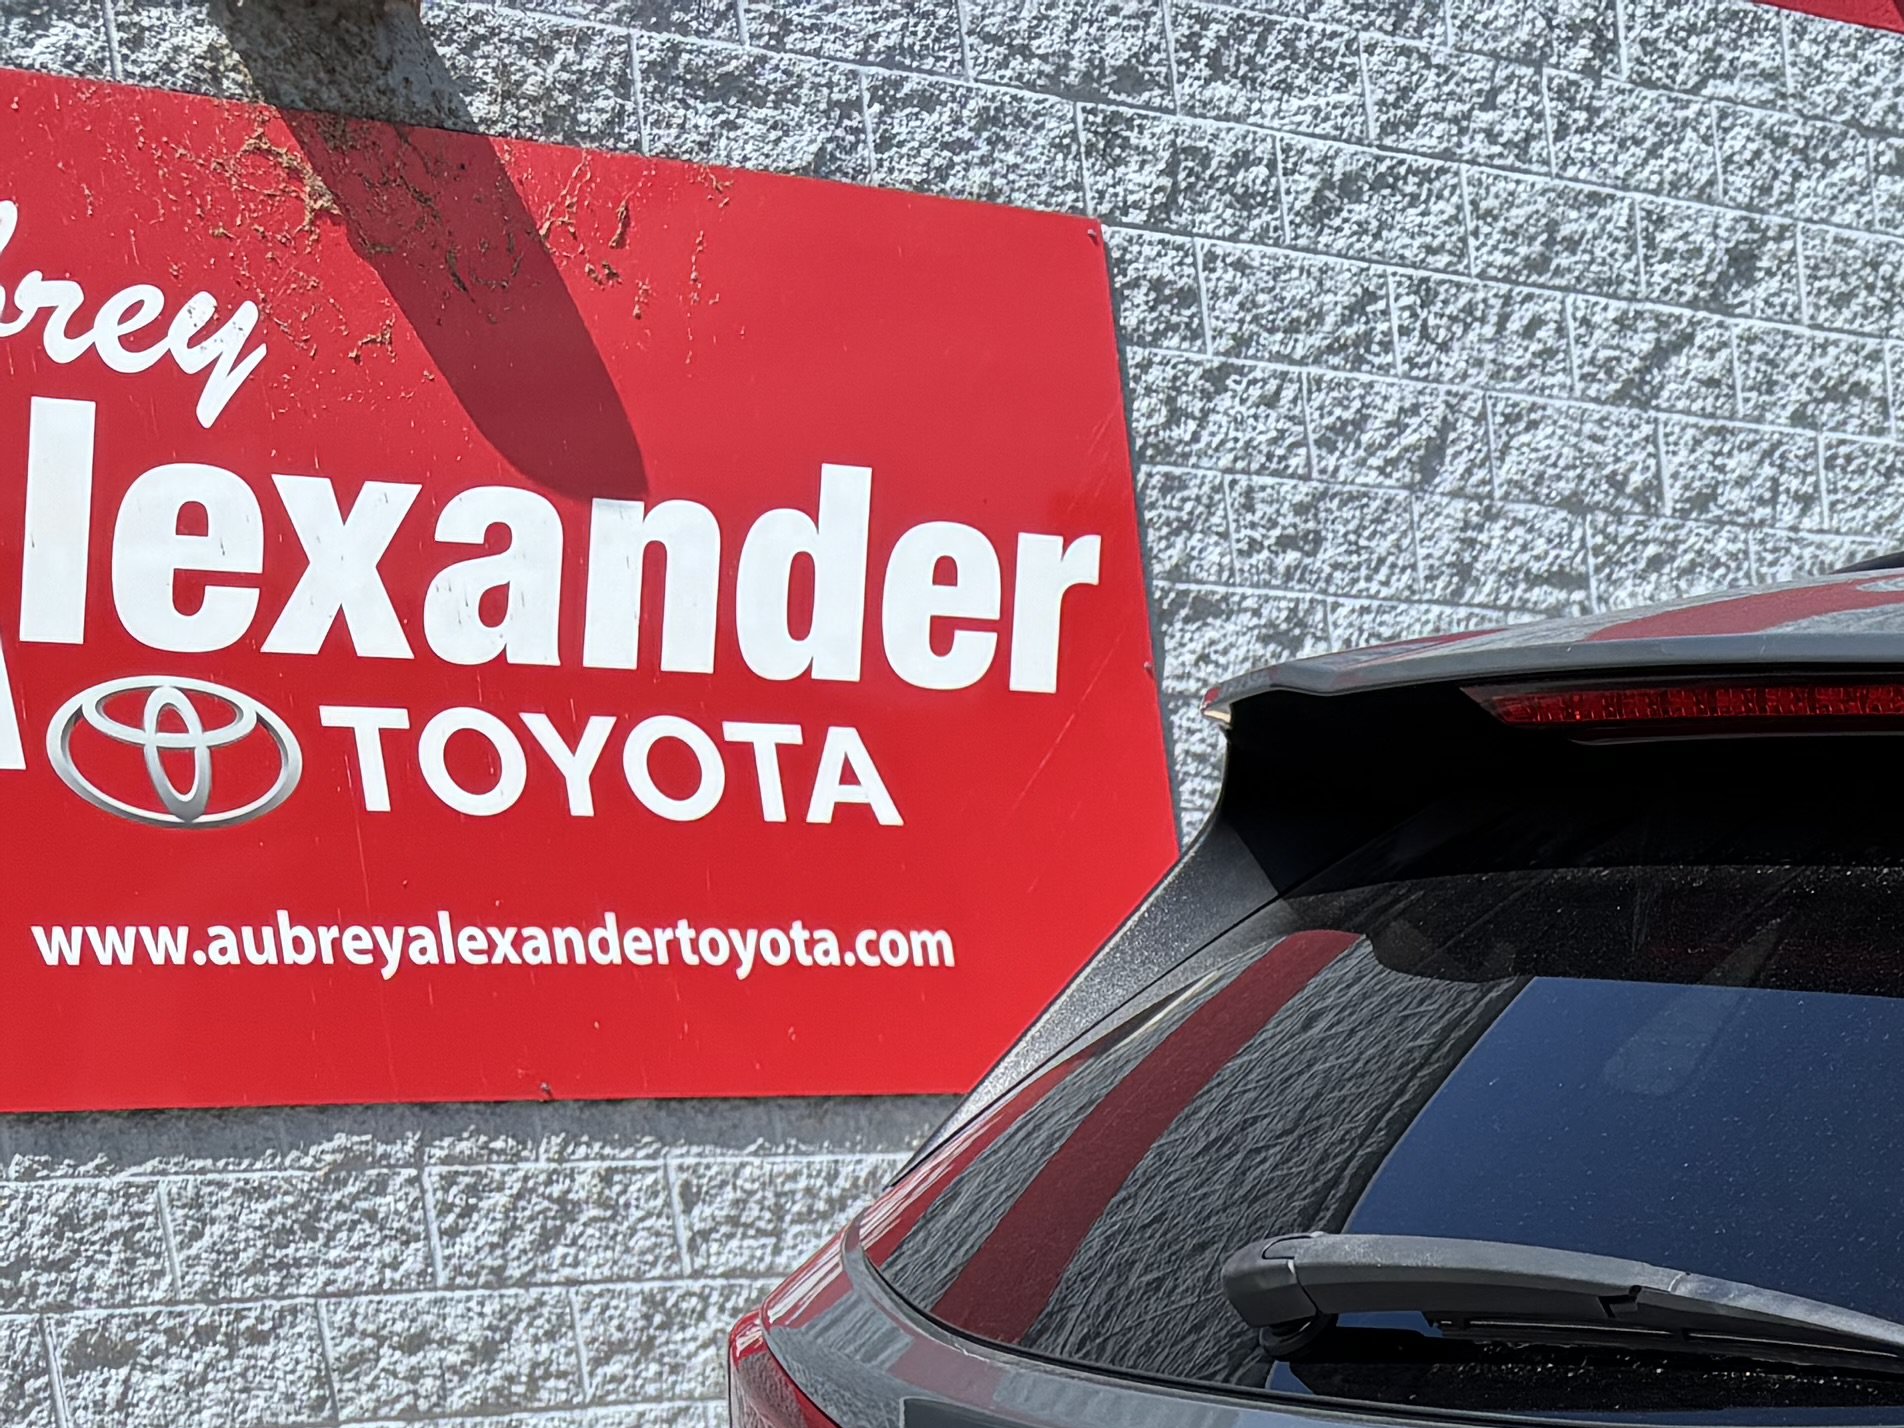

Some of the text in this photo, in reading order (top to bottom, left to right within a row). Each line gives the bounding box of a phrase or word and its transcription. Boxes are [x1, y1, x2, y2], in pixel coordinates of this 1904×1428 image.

[0, 396, 1101, 769] lexander
[319, 705, 905, 827] TOYOTA
[32, 910, 956, 981] www.aubreyalexandertoyota.com
